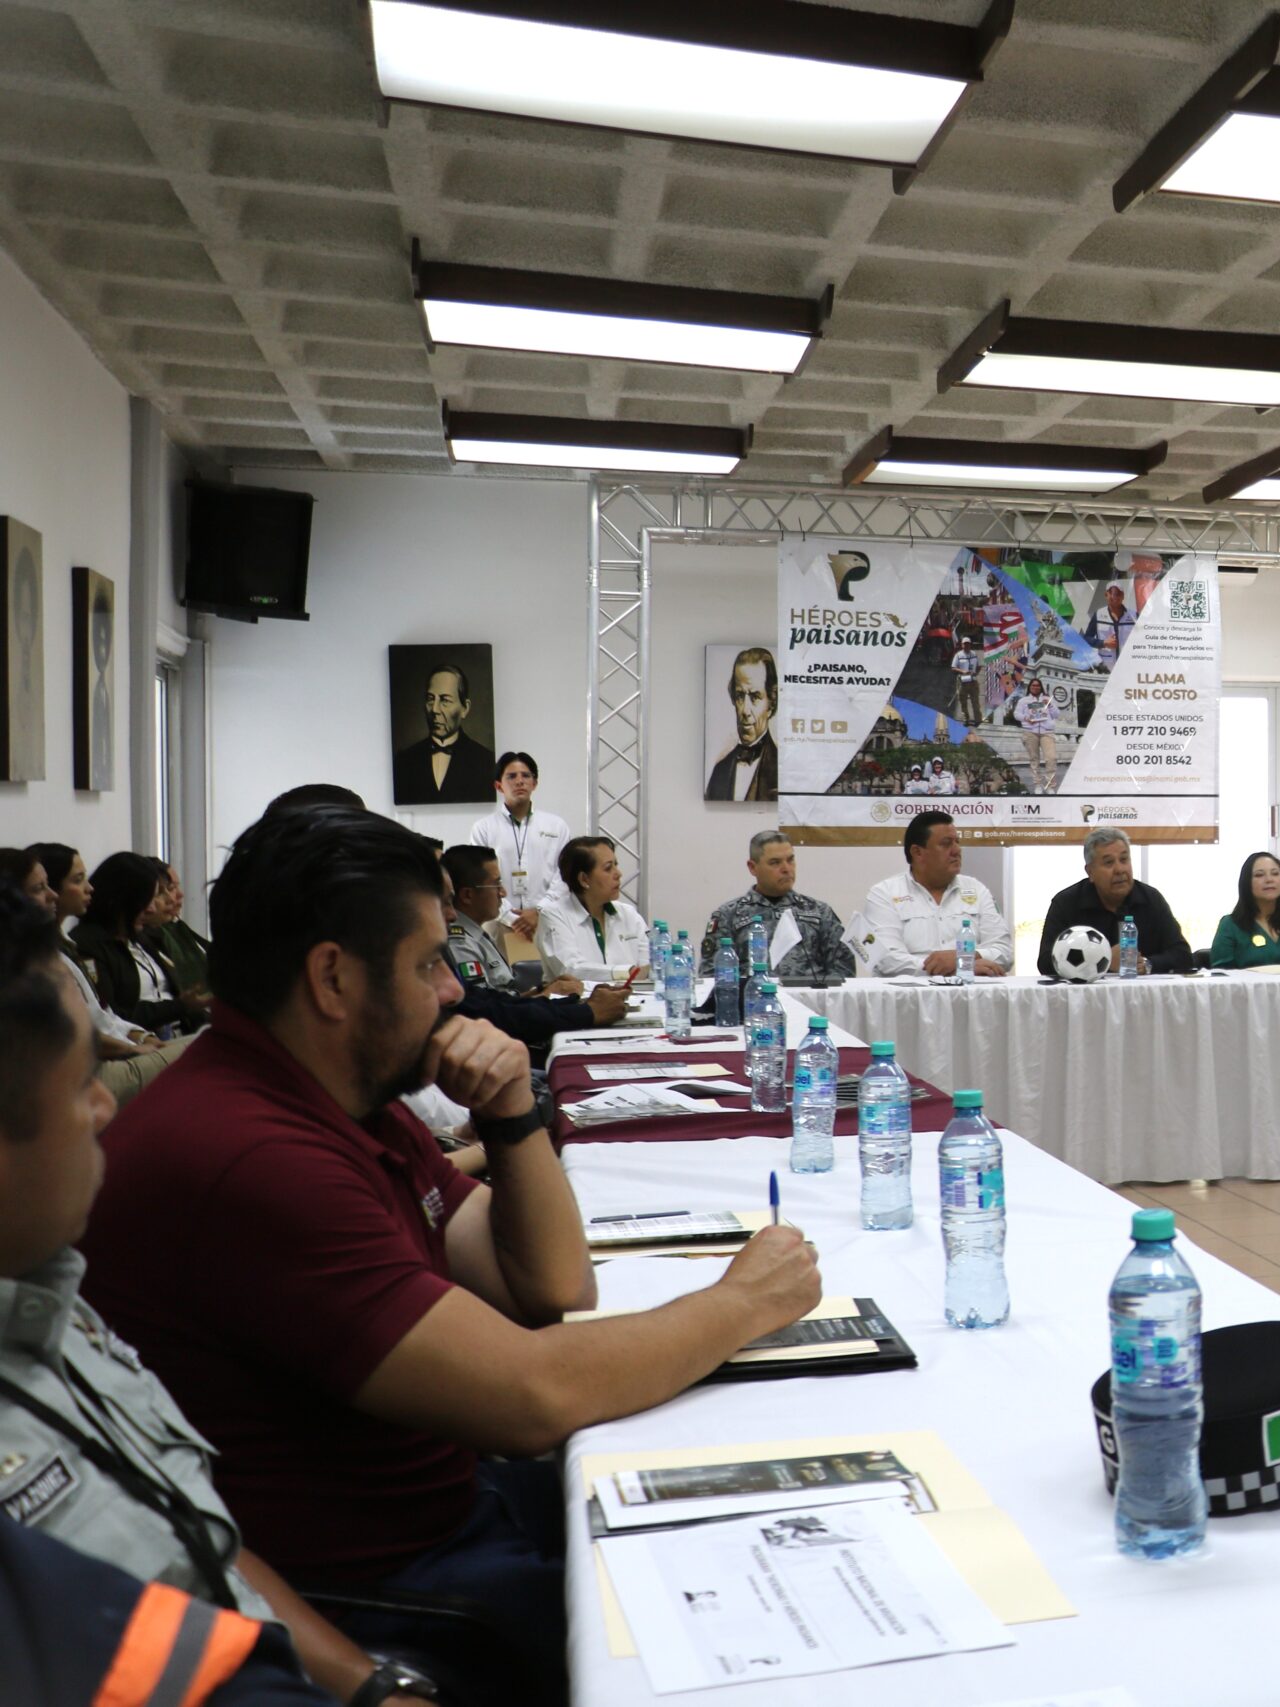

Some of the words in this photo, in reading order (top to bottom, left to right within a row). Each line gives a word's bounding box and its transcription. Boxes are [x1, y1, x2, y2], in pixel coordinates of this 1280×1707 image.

[790, 605, 882, 627] HÉROES
[789, 624, 907, 650] paisanos
[808, 664, 867, 674] ¿PAISANO,
[784, 675, 844, 684] NECESITAS
[847, 677, 891, 686] AYUDA?
[1137, 673, 1186, 684] LLAMA
[1124, 688, 1148, 700] SIN
[1152, 689, 1198, 700] COSTO
[1136, 714, 1174, 722] ESTADOS
[1112, 726, 1118, 736] 1
[1121, 726, 1144, 736] 877
[1147, 726, 1166, 736] 210
[1170, 726, 1196, 736] 9469
[1156, 742, 1184, 750] MÉXICO
[1116, 755, 1140, 765] 800
[1144, 755, 1162, 765] 201
[1166, 755, 1192, 765] 8542
[894, 802, 994, 815] GOBERNACIÓN
[1097, 804, 1130, 812] HÉROES
[1097, 812, 1138, 820] paisanos
[984, 830, 1066, 838] gob.mx/heroespaisanos
[756, 1032, 773, 1041] ciel
[1112, 1343, 1136, 1369] iel
[1100, 1424, 1116, 1454] G
